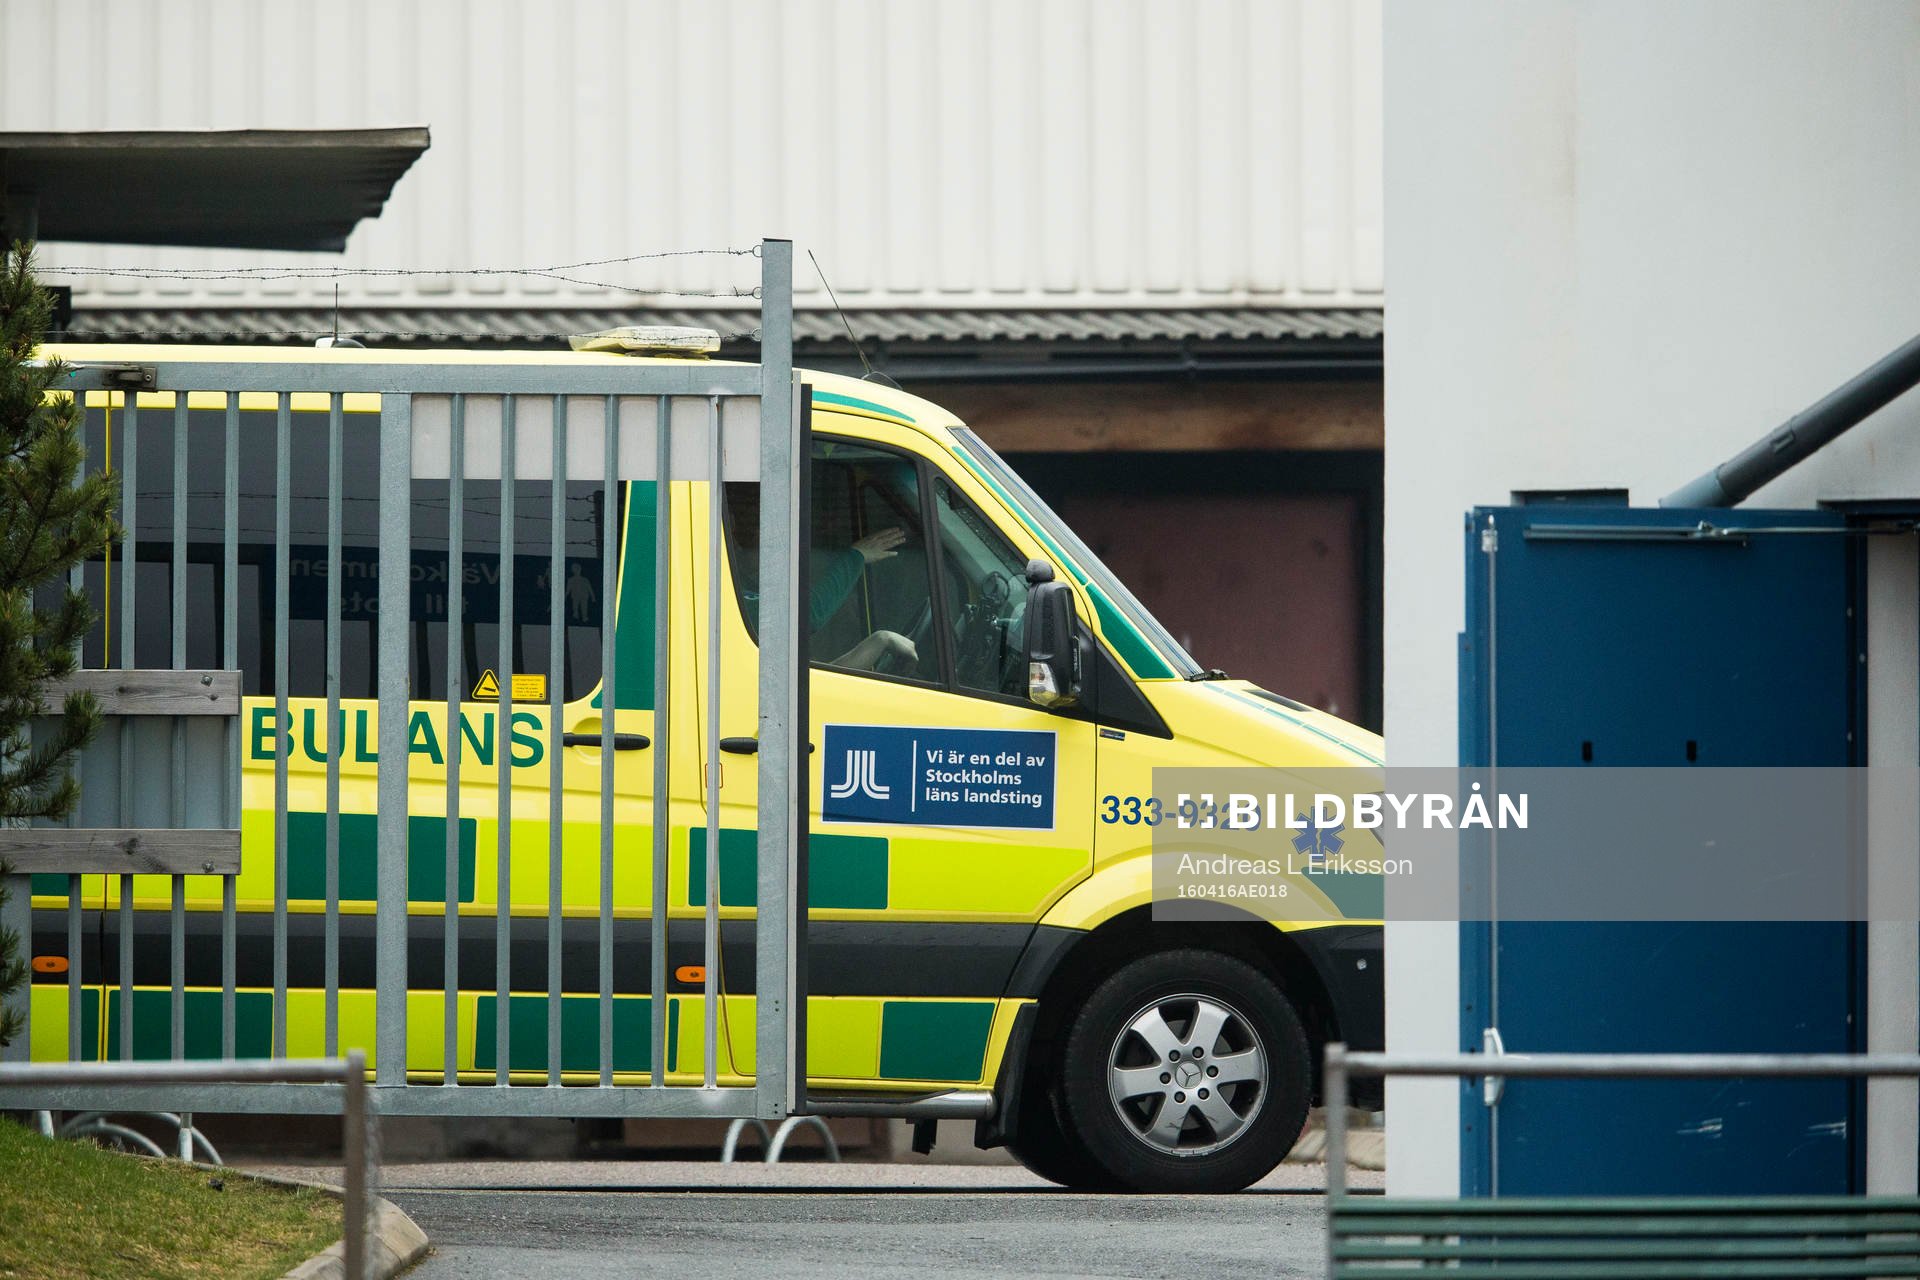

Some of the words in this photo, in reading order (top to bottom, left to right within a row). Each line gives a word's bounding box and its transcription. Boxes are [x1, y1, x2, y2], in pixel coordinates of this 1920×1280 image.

[251, 707, 545, 768] BULANS
[926, 750, 943, 764] Vi
[948, 750, 965, 765] är
[970, 754, 990, 765] en
[995, 752, 1021, 766] del
[1026, 757, 1045, 767] av
[926, 769, 1022, 785] Stockholms
[926, 788, 959, 802] läns
[964, 789, 1042, 808] landsting
